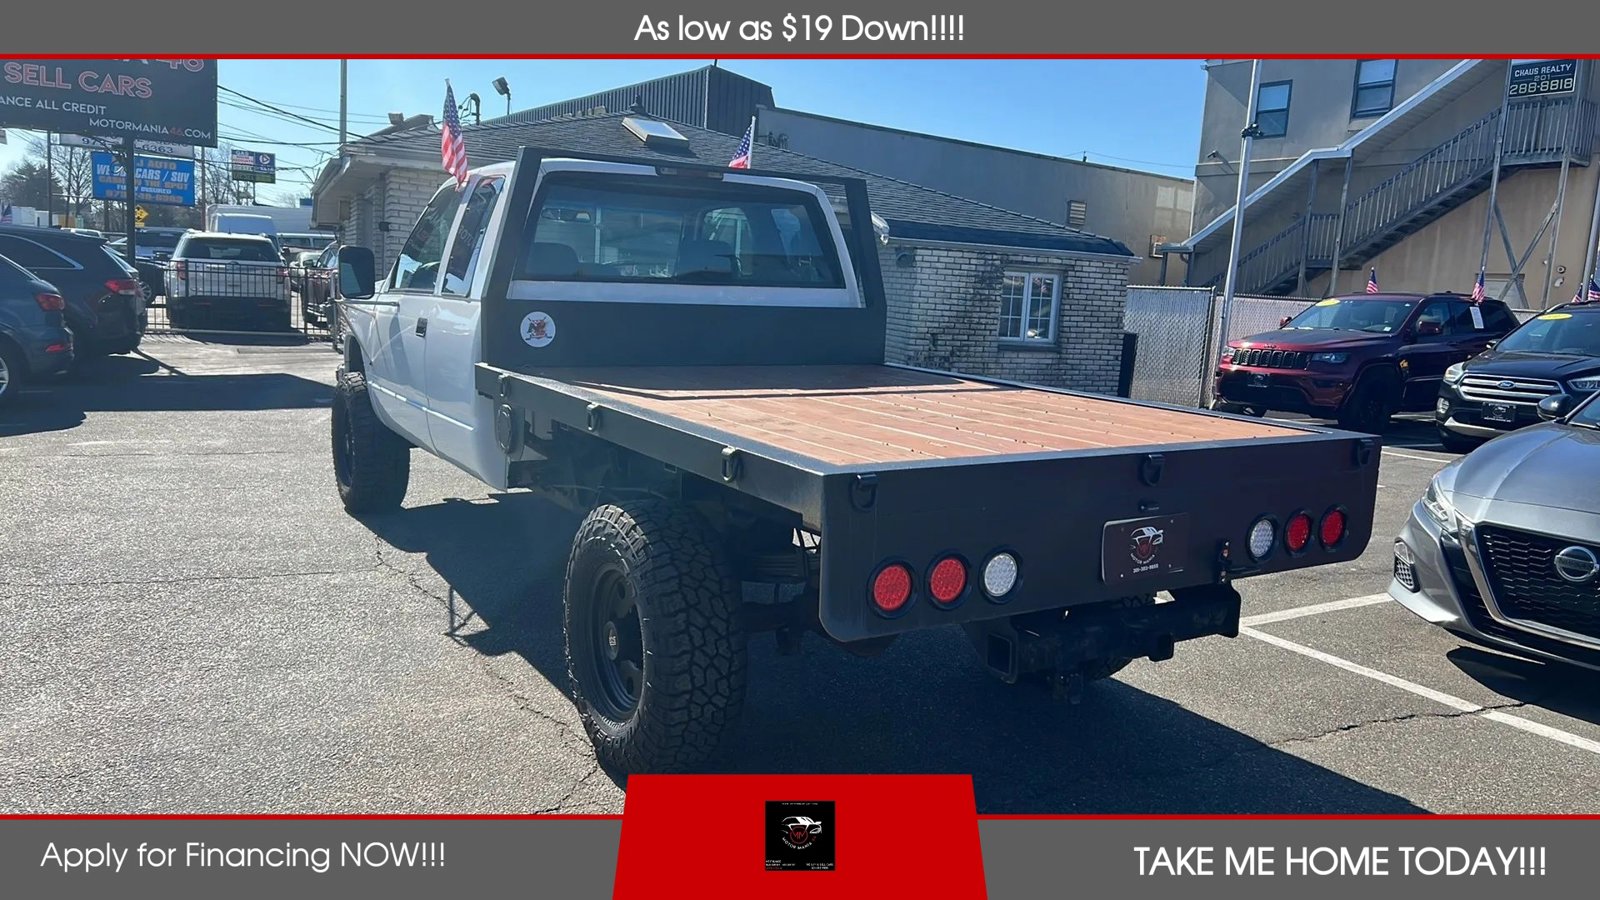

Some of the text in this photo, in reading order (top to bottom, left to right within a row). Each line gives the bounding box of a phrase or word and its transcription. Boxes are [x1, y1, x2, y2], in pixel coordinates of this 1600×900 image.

[1514, 63, 1572, 77] CHAUS REALTY
[4, 62, 152, 98] SELL CARS
[1509, 78, 1573, 95] 288-8818
[35, 99, 60, 111] ALL
[62, 101, 107, 115] CREDIT
[135, 168, 161, 180] CARS
[171, 171, 190, 183] SUV
